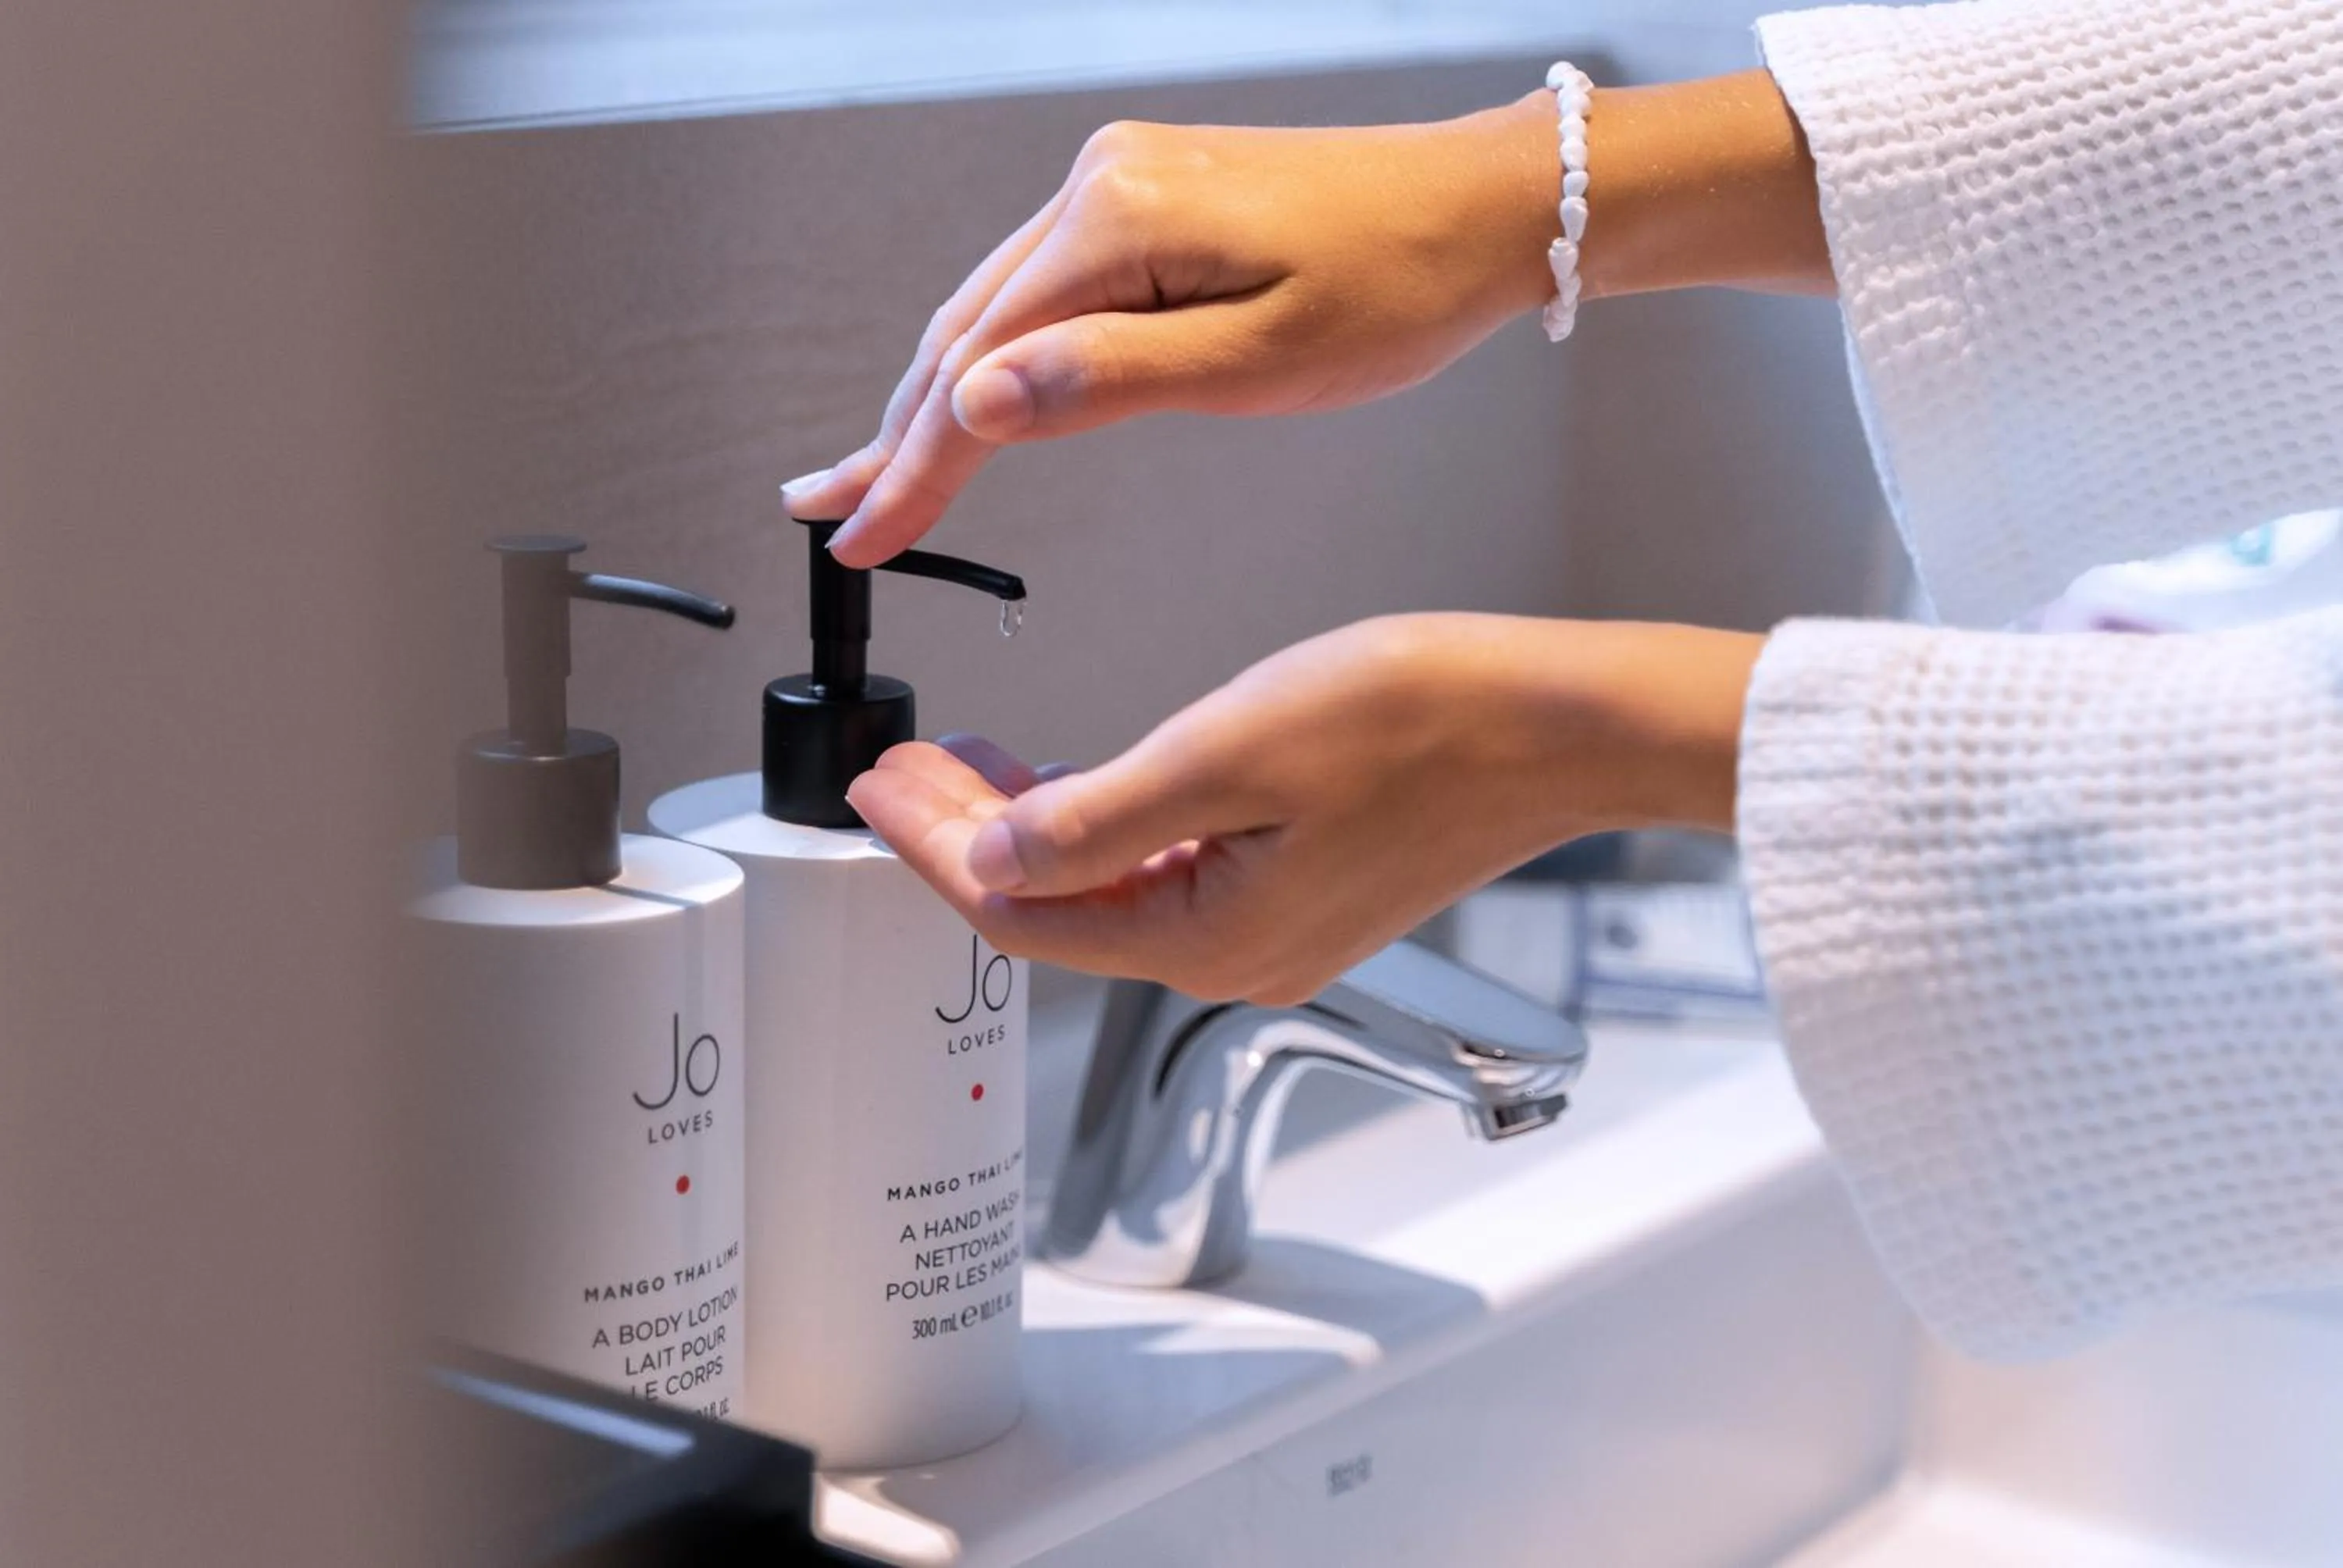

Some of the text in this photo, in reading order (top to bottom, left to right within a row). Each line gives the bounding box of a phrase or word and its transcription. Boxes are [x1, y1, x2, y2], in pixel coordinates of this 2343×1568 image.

[935, 934, 1012, 1024] Jo
[947, 1025, 1006, 1055] LOVES
[632, 1012, 720, 1110] Jo
[647, 1110, 714, 1144] LOVES
[886, 1178, 961, 1201] MANGO
[968, 1163, 1001, 1186] THAI
[899, 1224, 916, 1243] A
[924, 1210, 982, 1238] HAND
[915, 1221, 1014, 1270] NETTOYANT
[583, 1240, 740, 1304] MANGO THAI LIME
[886, 1274, 950, 1302] POUR
[955, 1263, 987, 1290] LES
[591, 1285, 738, 1349] A BODY LOTION
[911, 1317, 939, 1340] 300
[625, 1325, 726, 1376] LAIT POUR
[665, 1356, 724, 1395] CORPS
